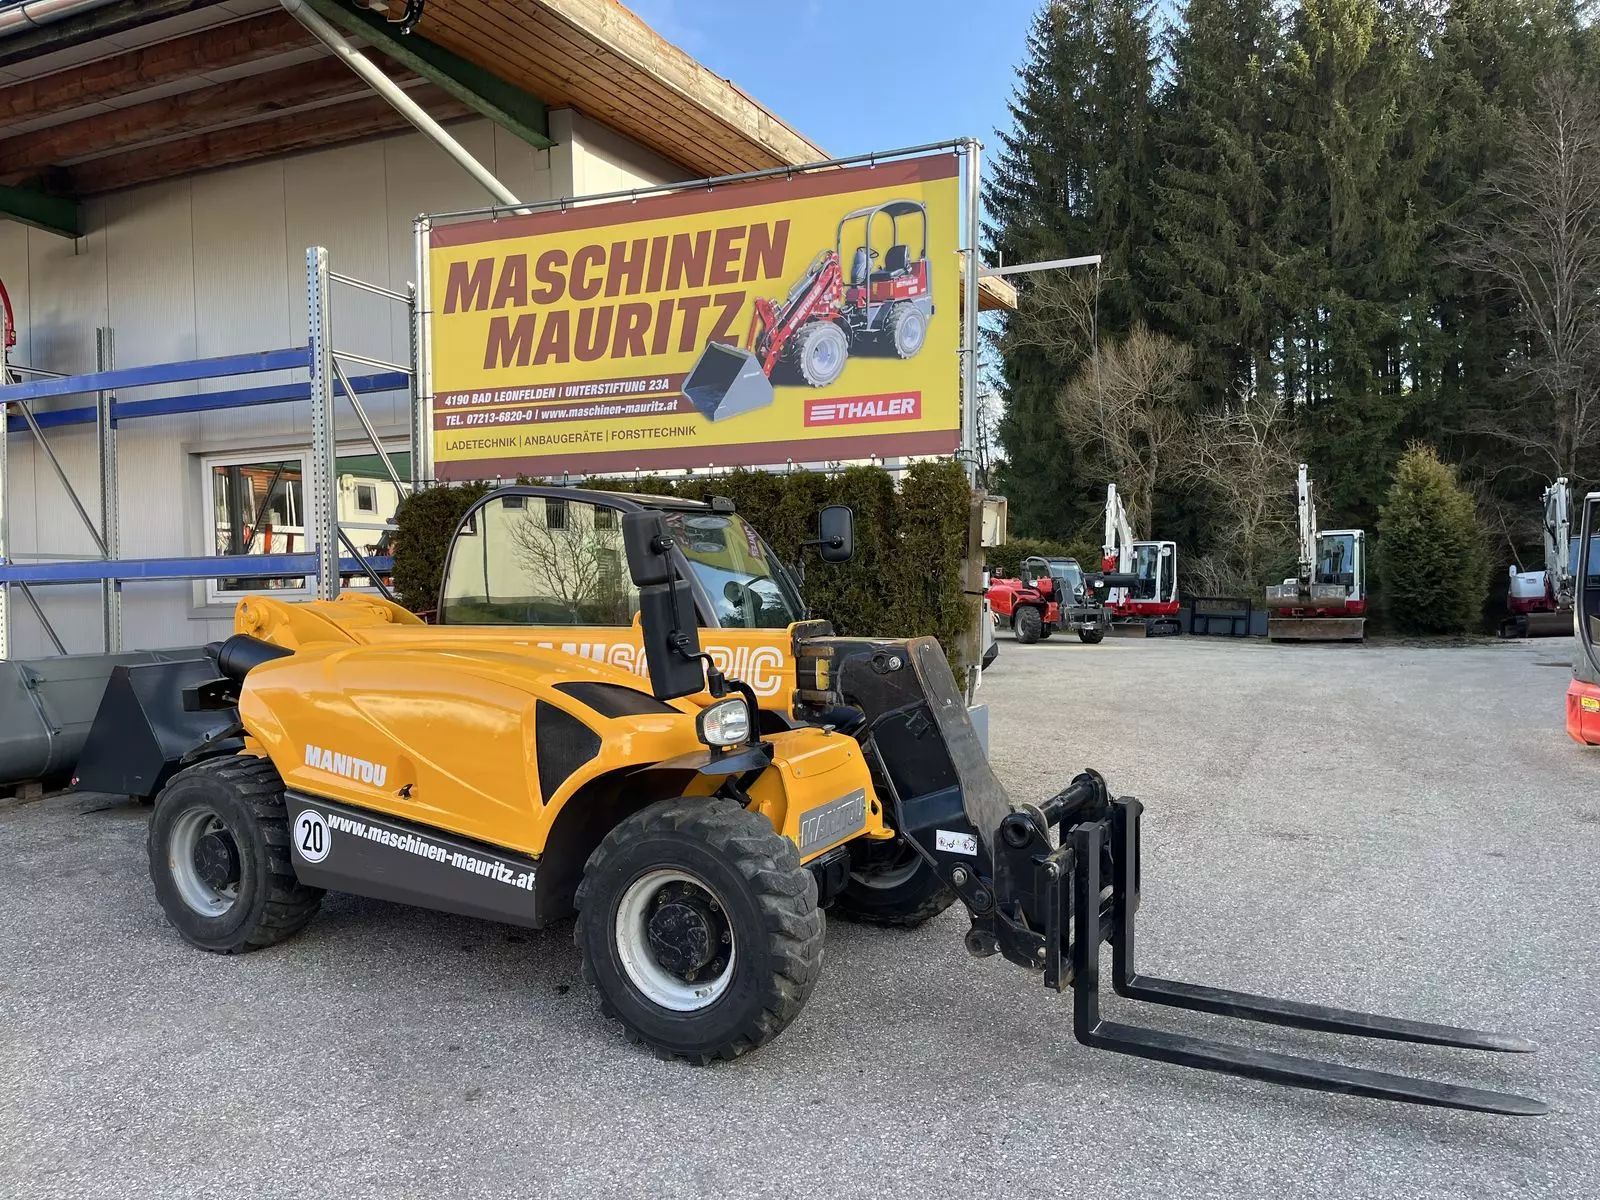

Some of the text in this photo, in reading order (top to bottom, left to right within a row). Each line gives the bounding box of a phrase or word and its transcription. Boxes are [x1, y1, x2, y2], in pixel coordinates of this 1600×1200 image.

[443, 219, 791, 315] MASCHINEN
[483, 290, 747, 370] MAURITZ
[445, 378, 670, 406] 4190 BAD LEONFELDEN UNTERSTIFTUNG 23A
[836, 397, 916, 420] THALER
[446, 399, 678, 426] TEL. 07213-6820-0 www.maschinen-mauritz.at
[446, 425, 697, 451] LADETECHNIK ANBAUGERÄTE FORSTTECHNIK
[304, 744, 388, 787] MANITOU
[302, 819, 323, 853] 20
[327, 813, 536, 891] www.maschinen-mauritz.at
